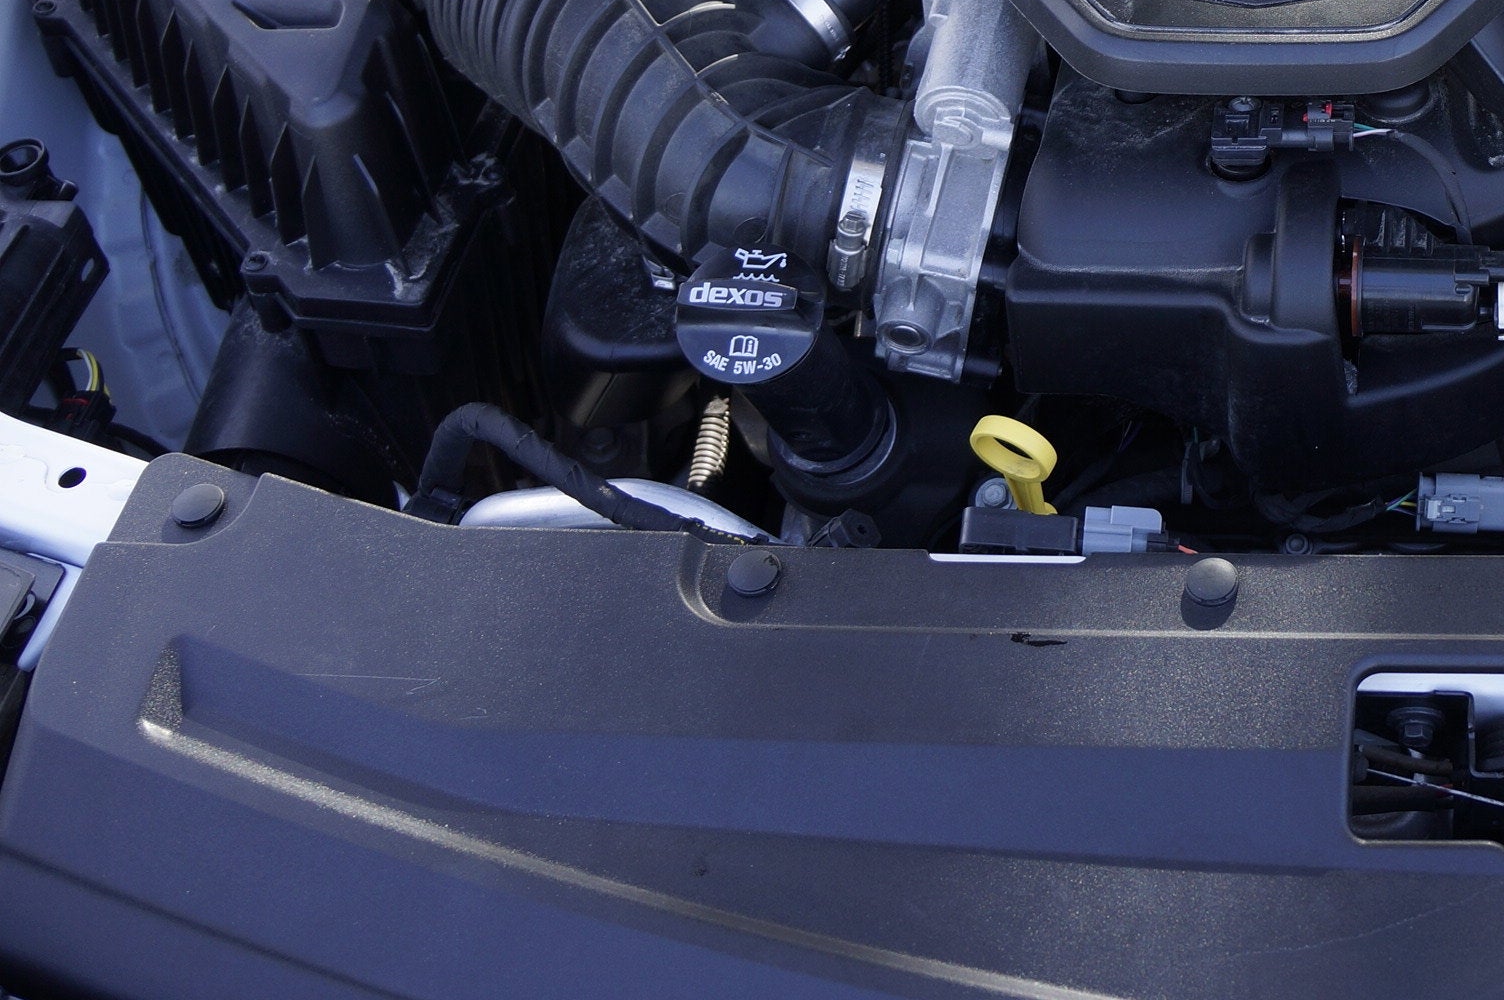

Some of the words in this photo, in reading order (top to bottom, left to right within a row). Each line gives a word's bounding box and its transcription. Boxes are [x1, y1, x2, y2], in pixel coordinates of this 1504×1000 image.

[689, 282, 783, 308] dexos
[703, 350, 729, 372] SAE
[733, 353, 782, 375] 5W-30
